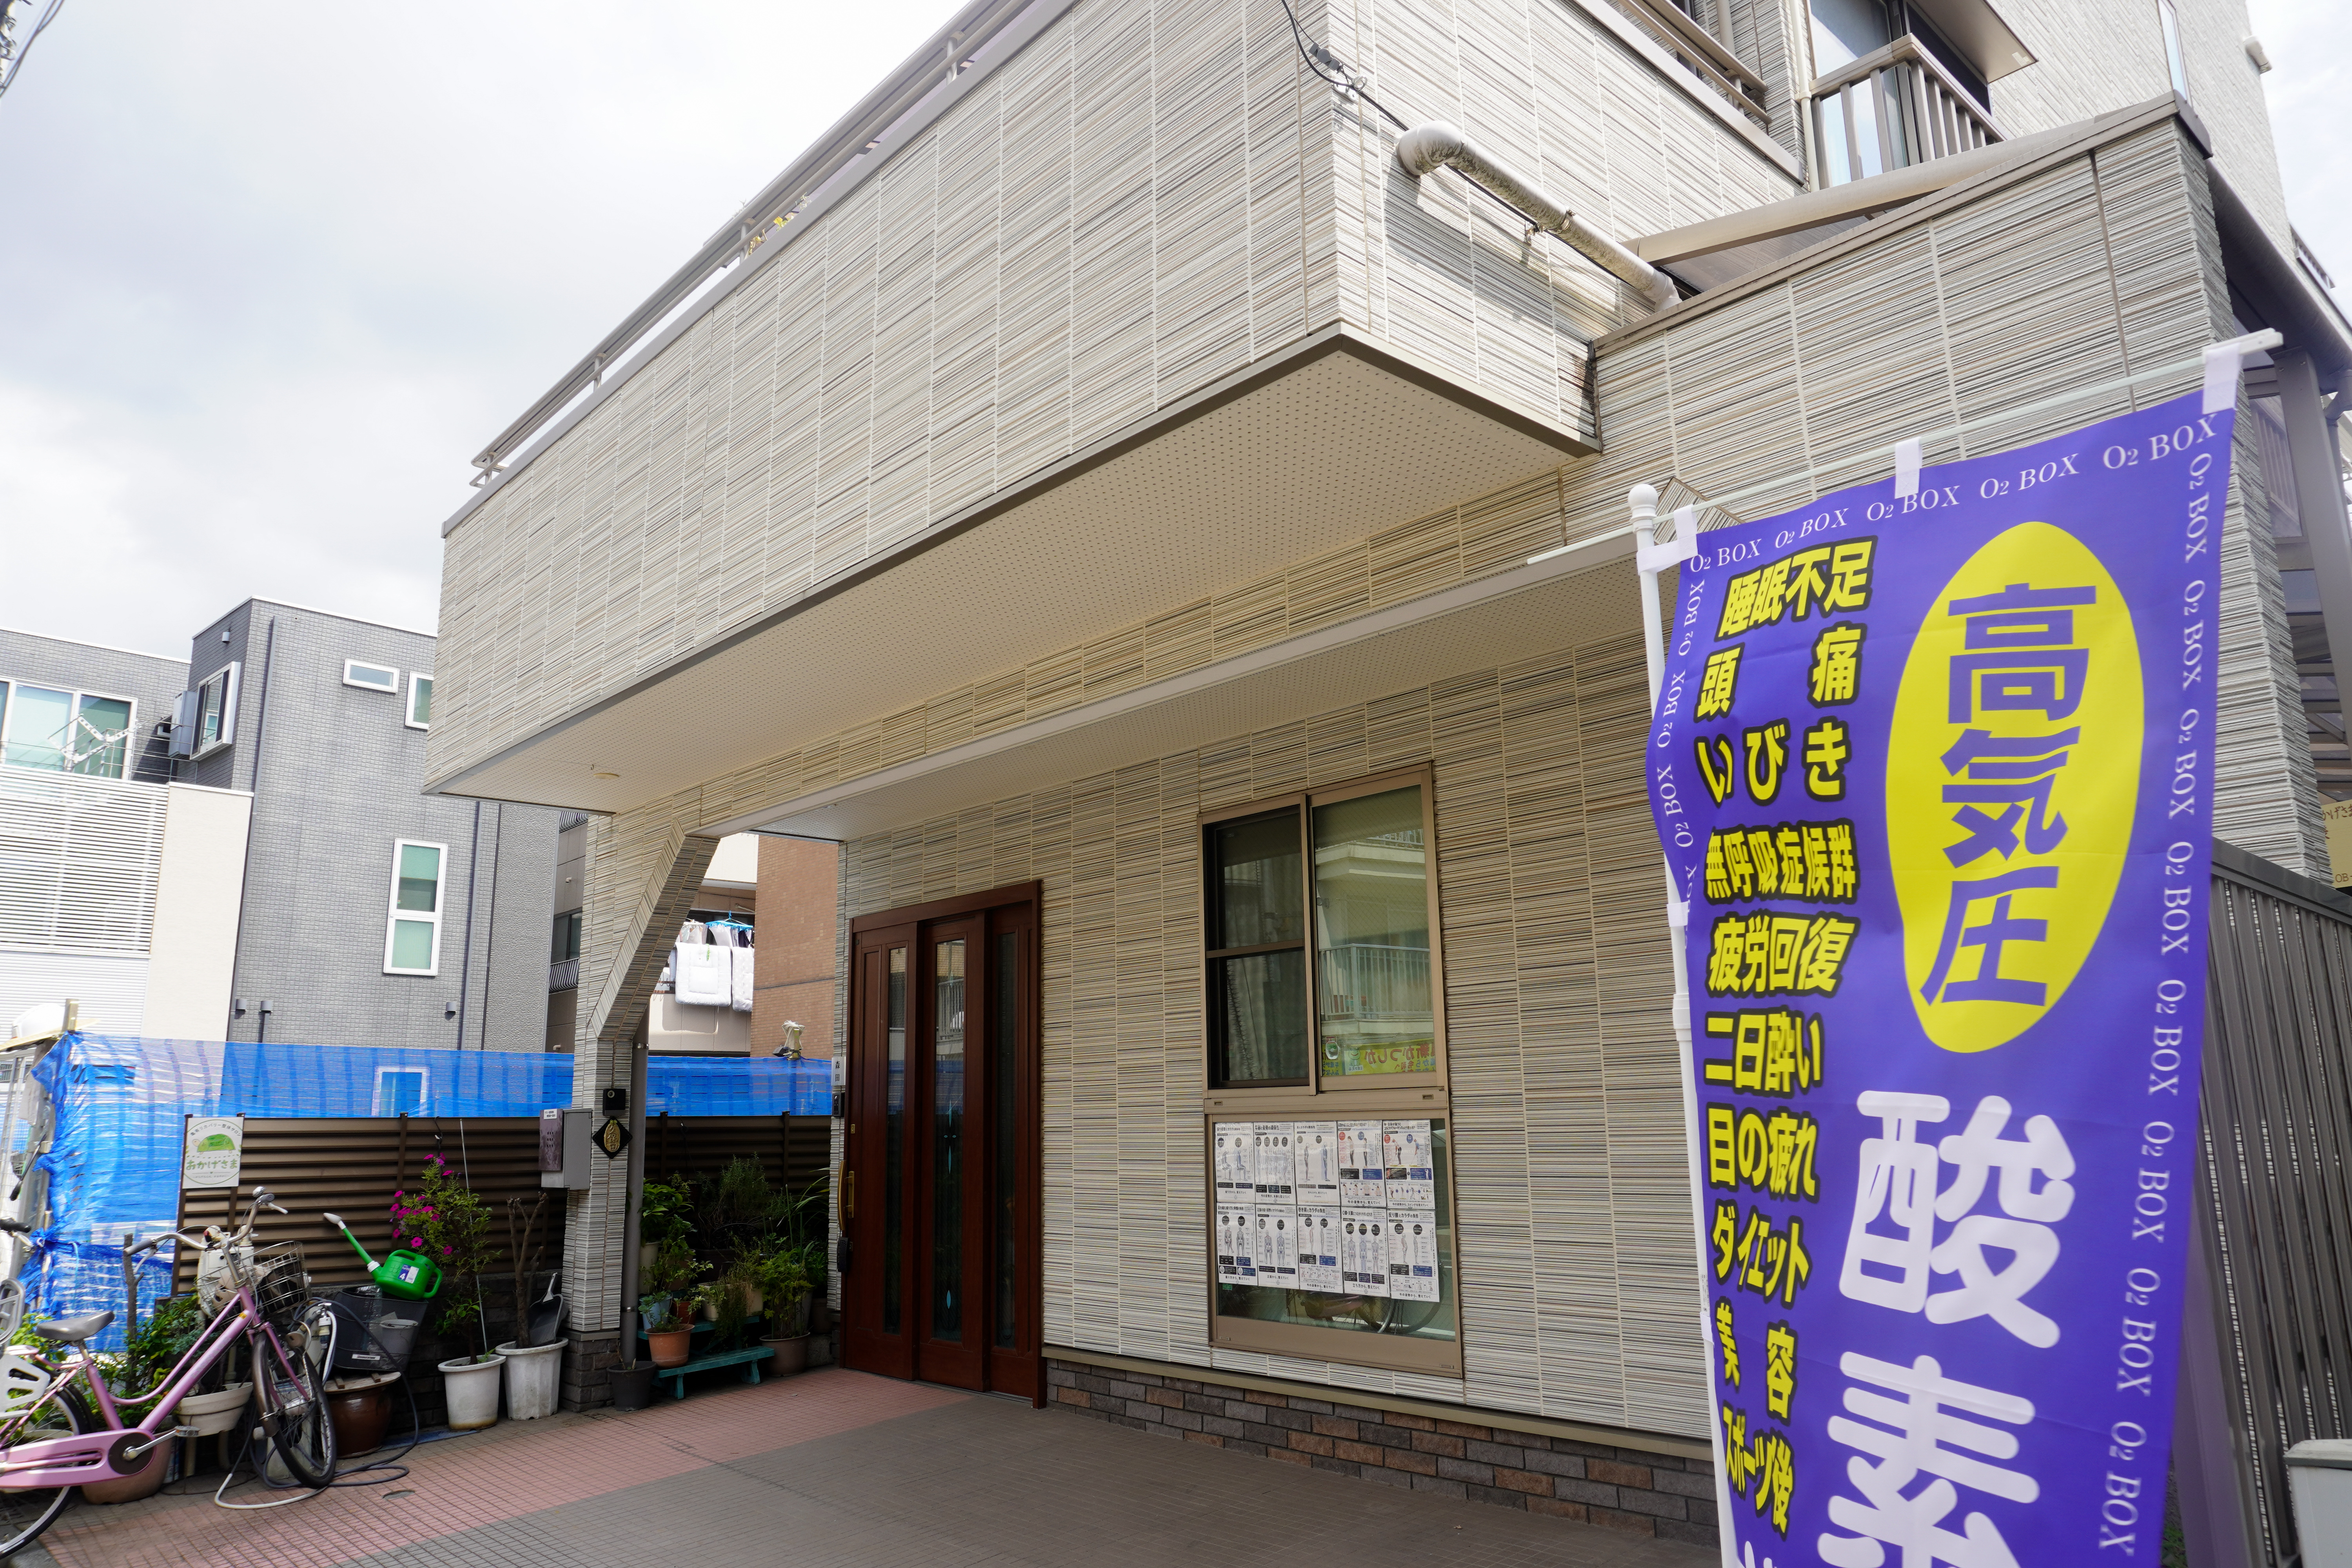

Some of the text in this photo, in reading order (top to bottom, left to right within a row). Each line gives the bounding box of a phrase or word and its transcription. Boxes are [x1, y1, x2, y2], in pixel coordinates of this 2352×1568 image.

[1690, 413, 2218, 572] O2 BOX O2 BOX O2 BOX O2 BOX O2 BOX
[1684, 579, 1705, 628] BOX
[1717, 540, 1873, 638] 睡眠不足
[1678, 631, 1693, 656] O2
[1663, 669, 1686, 718] BOX
[1657, 722, 1673, 748] O2
[1697, 721, 1847, 804] いびき
[1657, 764, 1683, 817] BOX
[1920, 582, 2096, 1007] 高気圧
[1675, 822, 1693, 847] O2
[1705, 824, 1857, 899] 無呼吸症候群
[1707, 914, 1856, 993] 疲労回復
[2098, 453, 2212, 1556] O2 BOX O2 BOX O2 BOX O2 BOX O2 BOX O2 BOX O2 BOX O2 BOX
[835, 1060, 840, 1082] 森田
[1704, 1010, 1821, 1093] 二日酔い
[186, 1158, 238, 1171] おかげさま
[607, 1125, 618, 1151] 久保田
[1707, 1107, 1818, 1197] 目の疲れ
[1711, 1204, 1810, 1303] ダイエット
[1817, 1089, 2076, 1568] 酸素
[1722, 1406, 1794, 1534] スポーツ後
